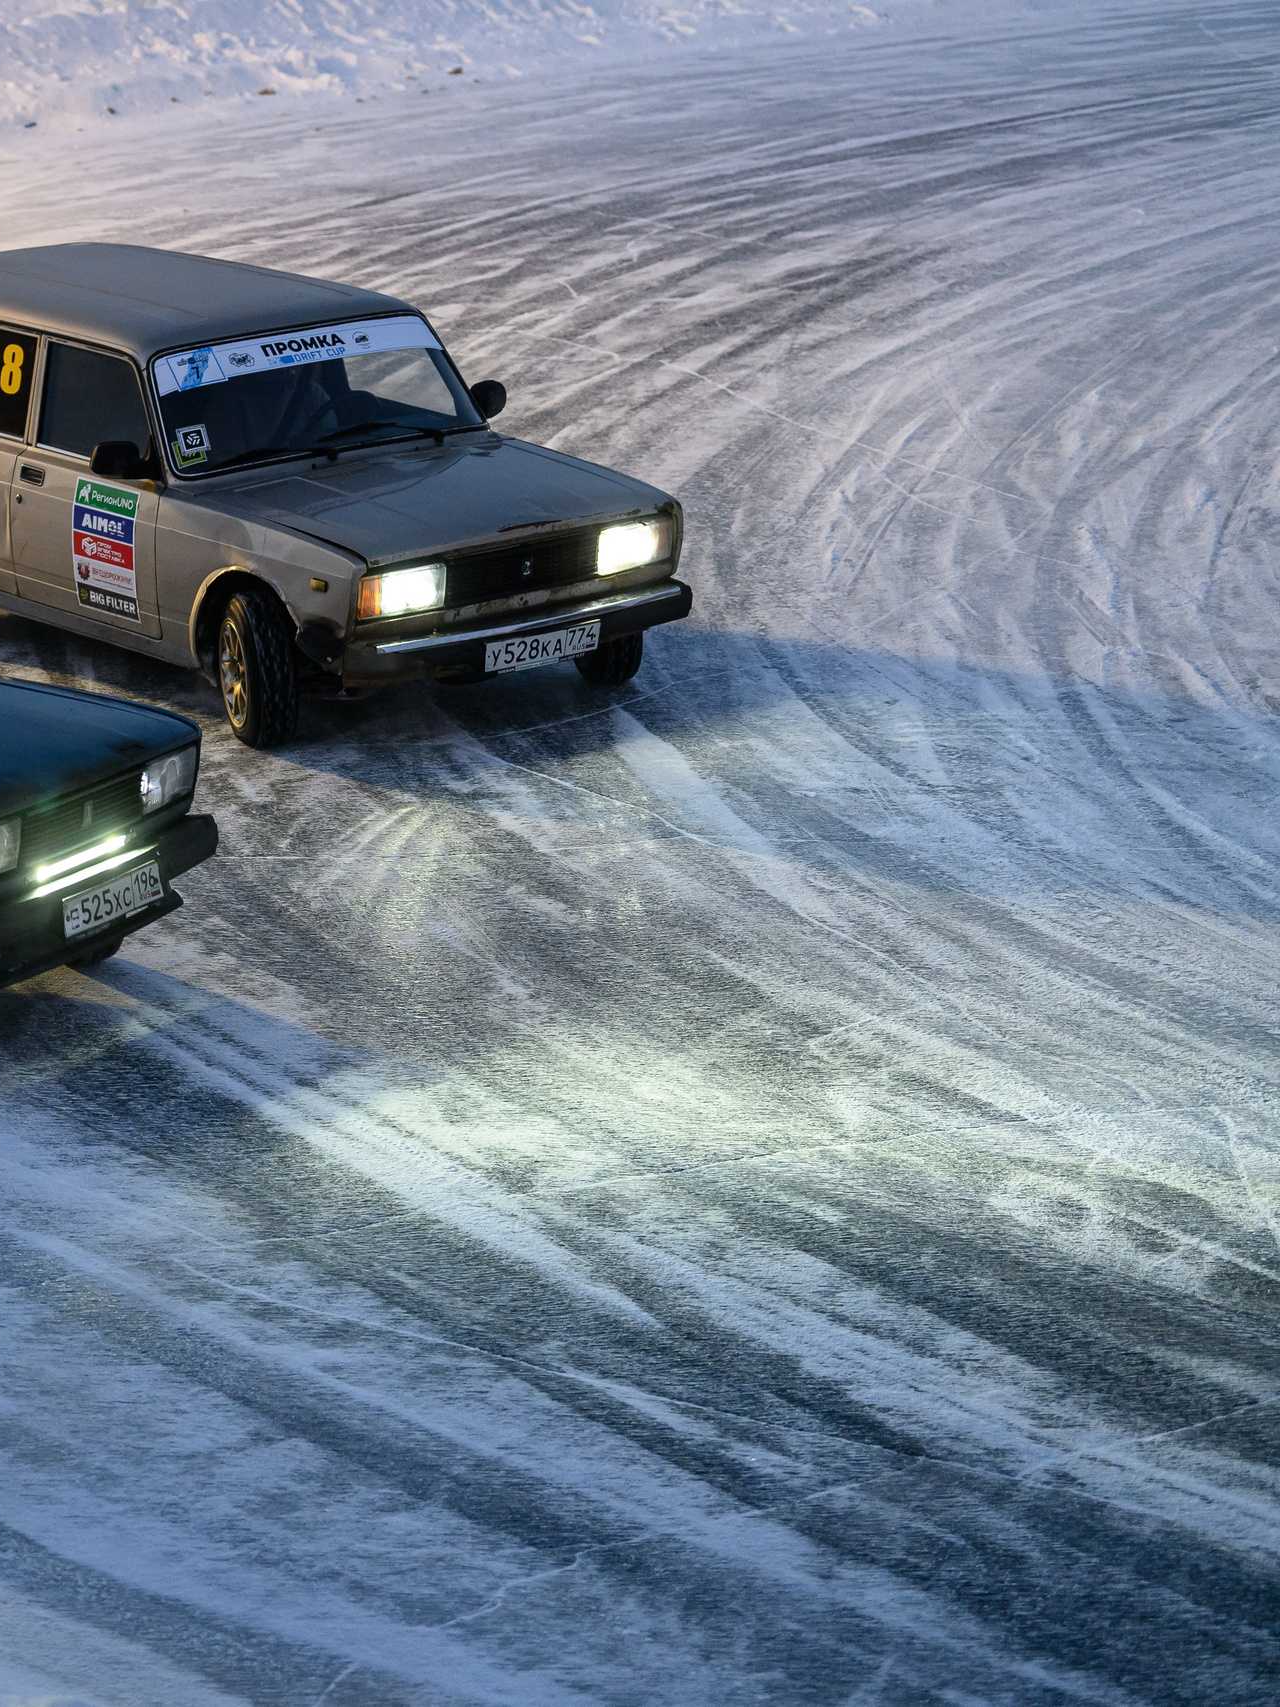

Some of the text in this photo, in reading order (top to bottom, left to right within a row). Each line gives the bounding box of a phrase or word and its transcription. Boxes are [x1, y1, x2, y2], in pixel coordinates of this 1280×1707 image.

[260, 333, 346, 357] ПРОМКА
[294, 346, 346, 363] DRIFT CUP
[92, 490, 134, 510] РегионUNO
[96, 541, 112, 550] ПРОМ
[96, 552, 125, 564] ПОСТАВКА
[89, 590, 136, 615] BIG FILTER
[568, 625, 595, 646] 774
[572, 643, 586, 652] RUS
[134, 868, 156, 893] 196
